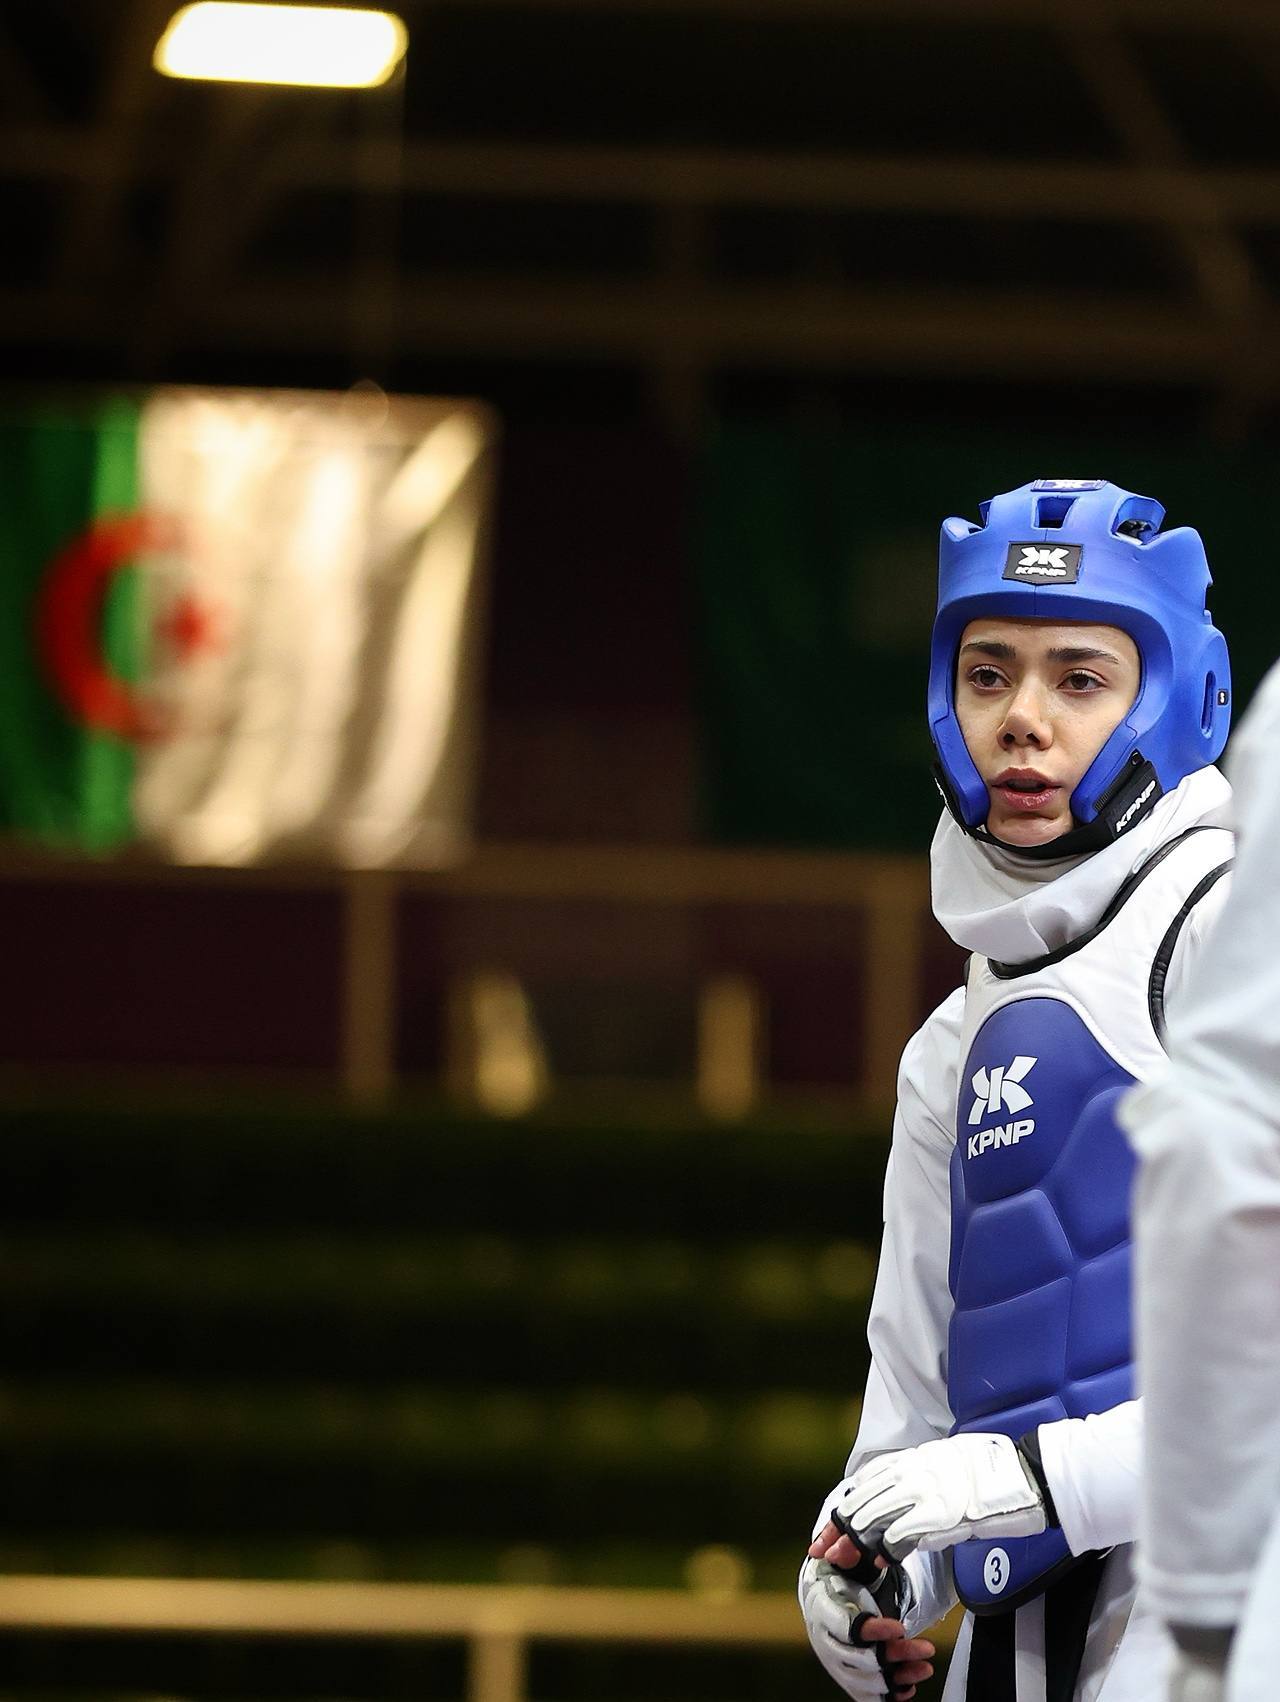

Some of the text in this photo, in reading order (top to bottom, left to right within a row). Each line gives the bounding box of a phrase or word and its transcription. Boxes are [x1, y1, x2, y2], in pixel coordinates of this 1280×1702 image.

[1015, 565, 1067, 577] KPNP
[1116, 780, 1156, 833] KPNP
[967, 1119, 1035, 1161] KPNP
[990, 1556, 1002, 1586] 3
